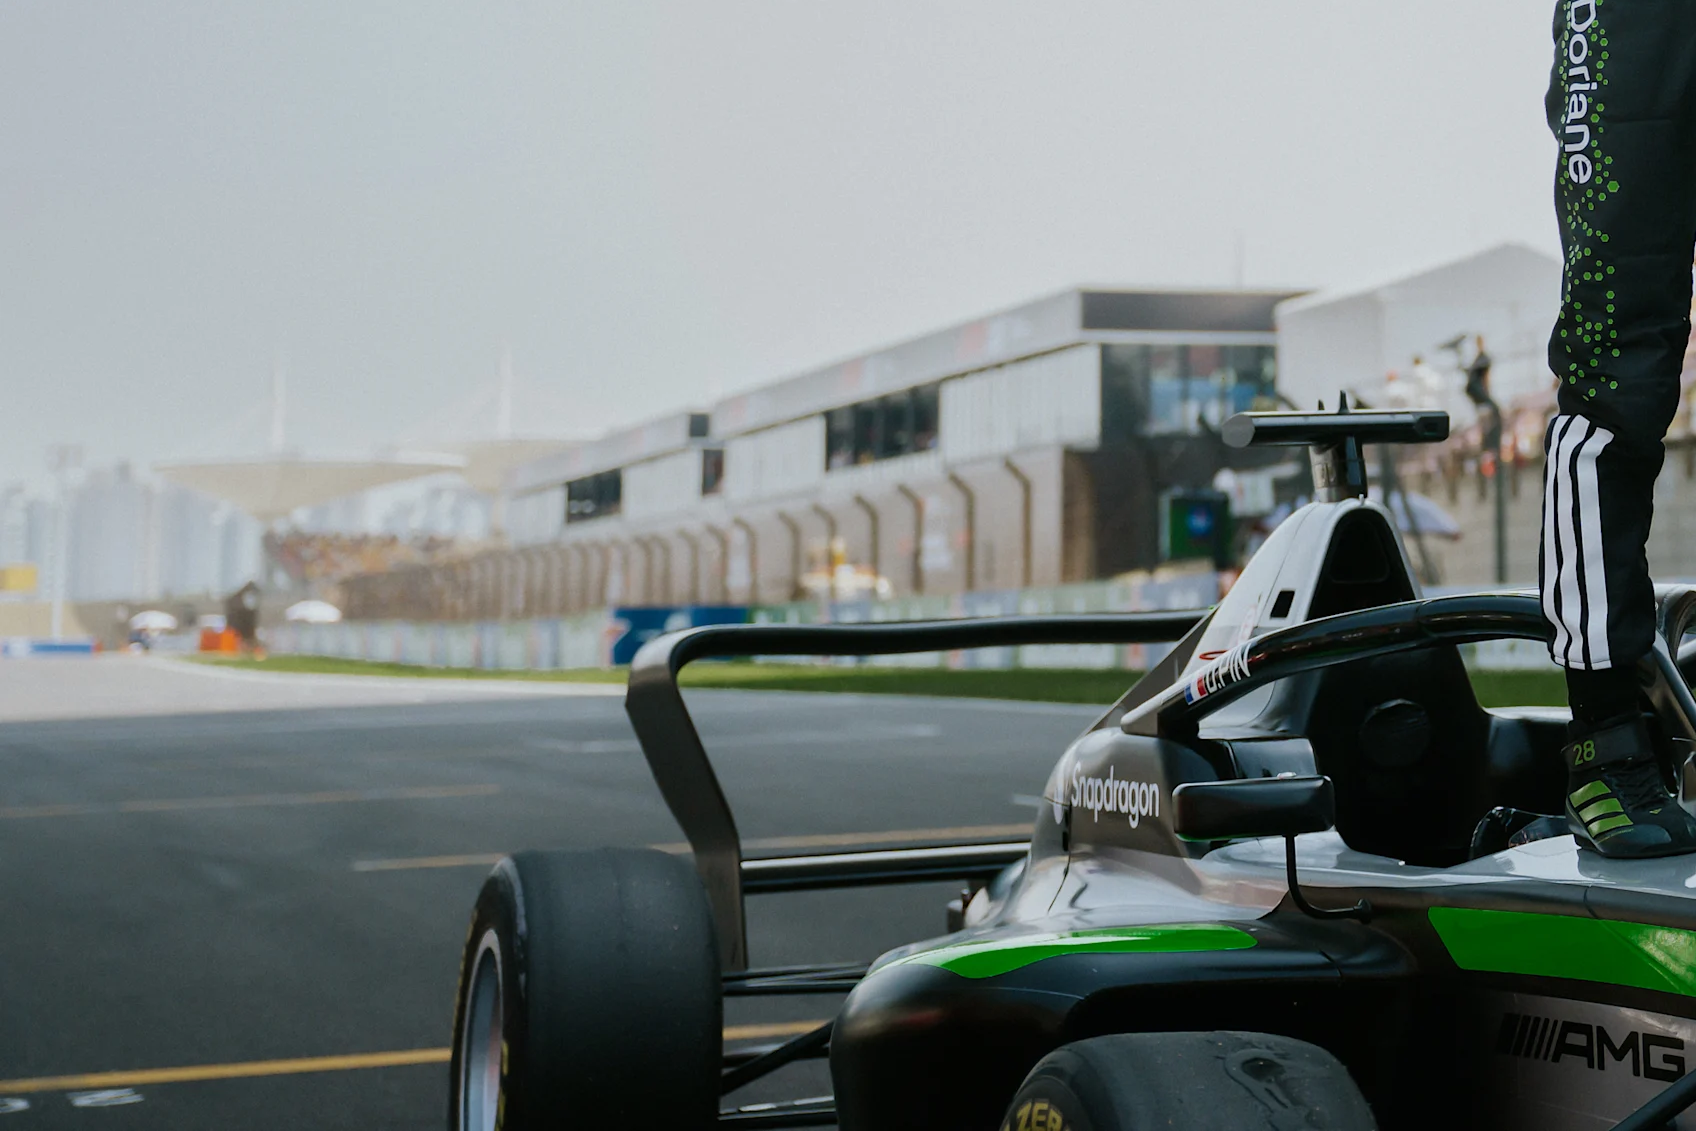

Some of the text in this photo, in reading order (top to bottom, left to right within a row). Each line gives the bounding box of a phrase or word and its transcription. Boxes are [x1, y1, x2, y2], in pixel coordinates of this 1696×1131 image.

[1572, 739, 1596, 766] 28
[1071, 760, 1160, 829] Snapdragon
[1551, 1020, 1686, 1083] AMG
